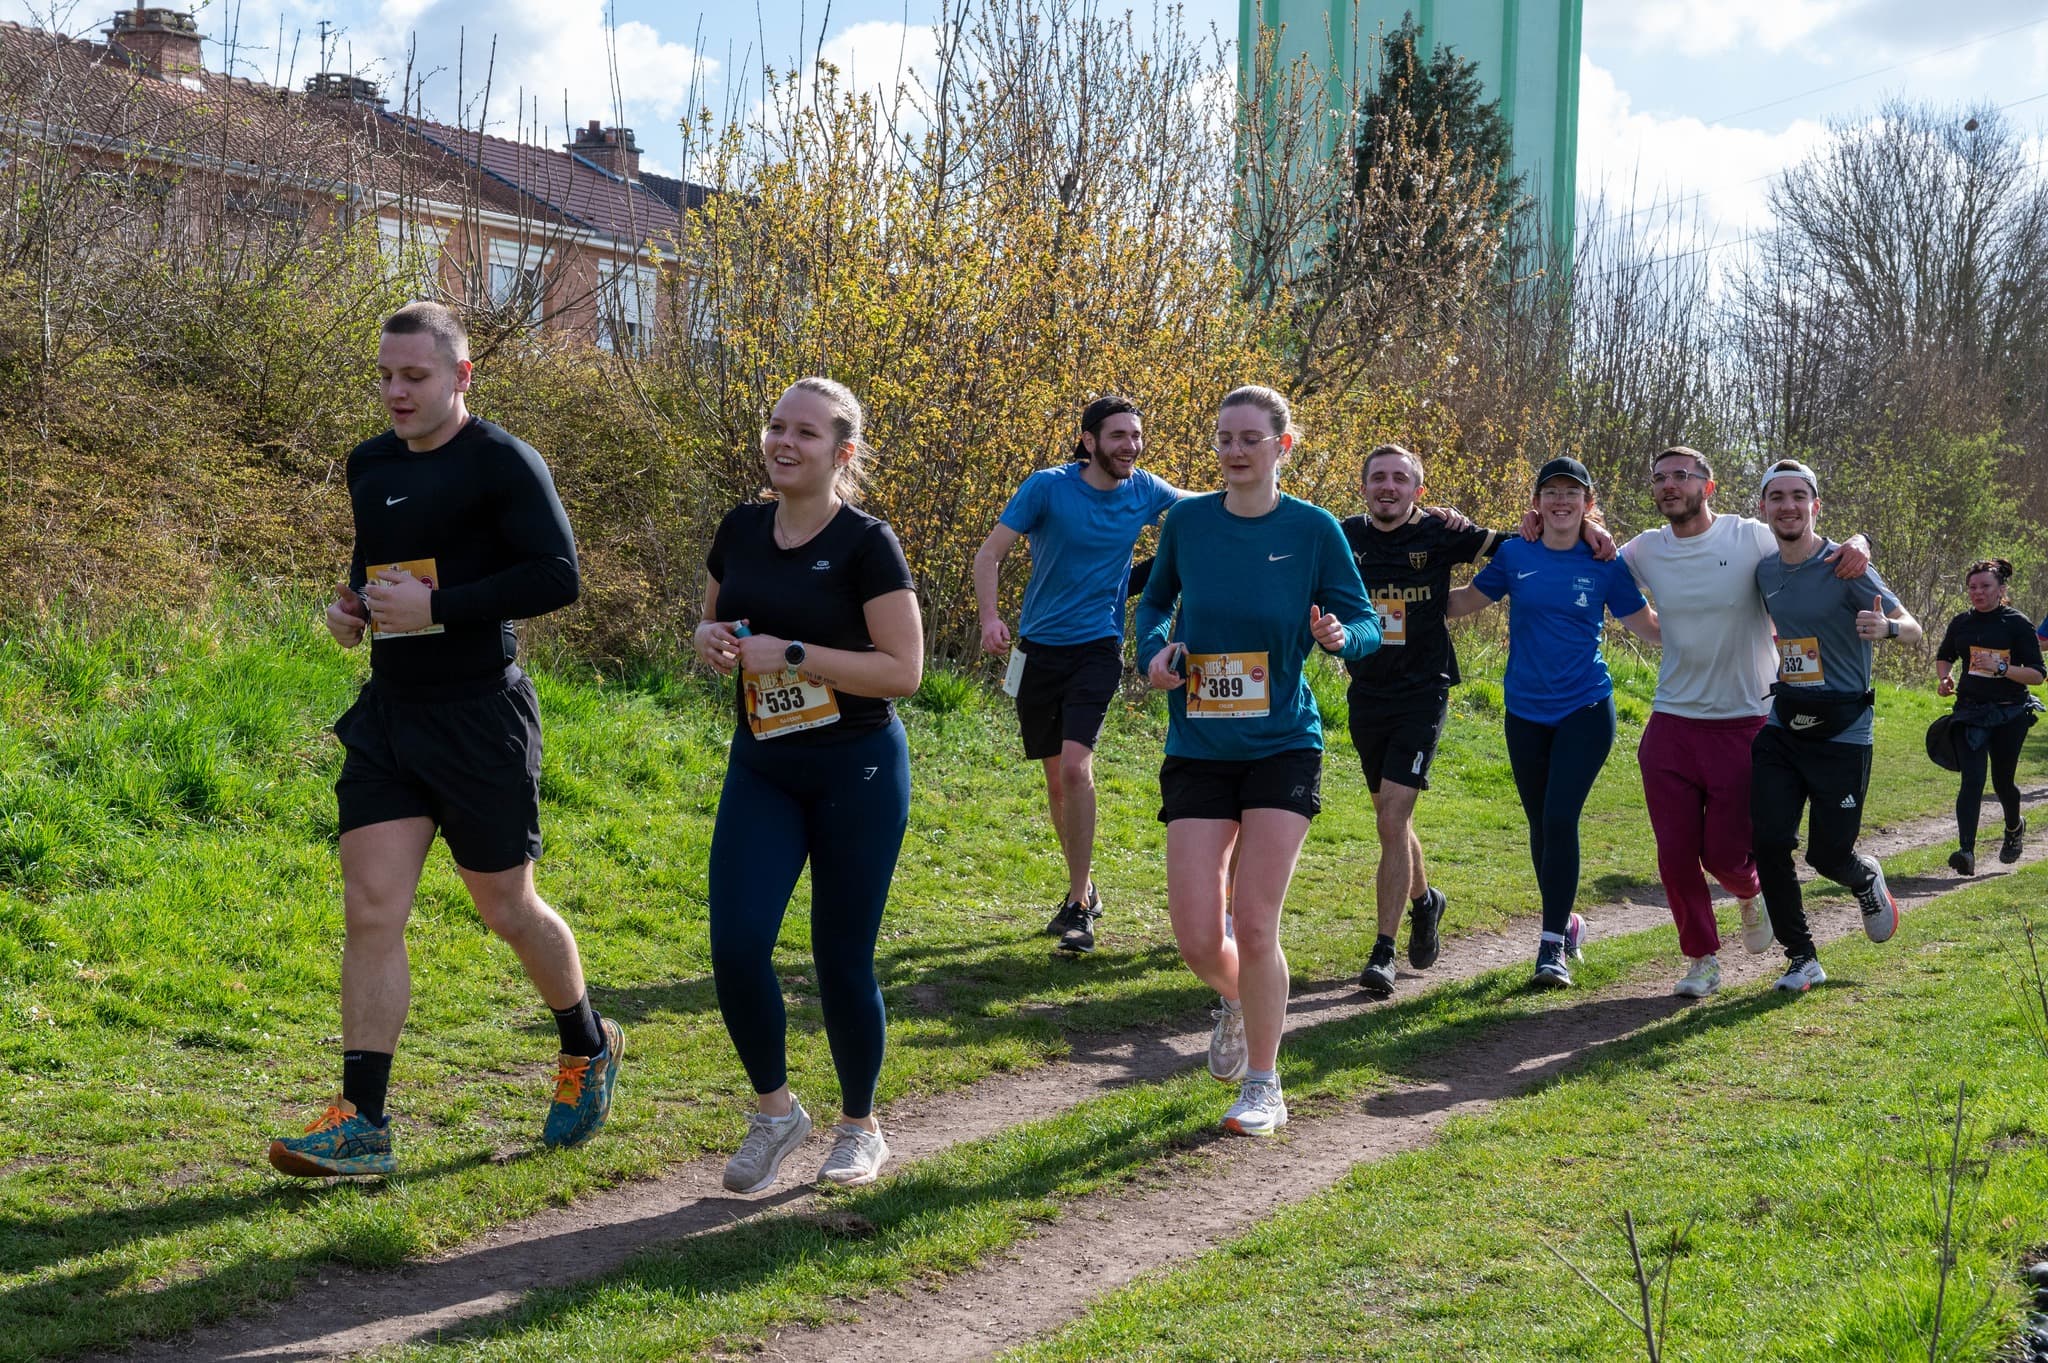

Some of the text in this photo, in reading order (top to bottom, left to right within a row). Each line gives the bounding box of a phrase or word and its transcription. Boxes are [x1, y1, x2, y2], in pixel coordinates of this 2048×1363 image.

[1208, 677, 1243, 698] 389
[765, 686, 805, 714] 533
[1794, 713, 1817, 726] NIKE
